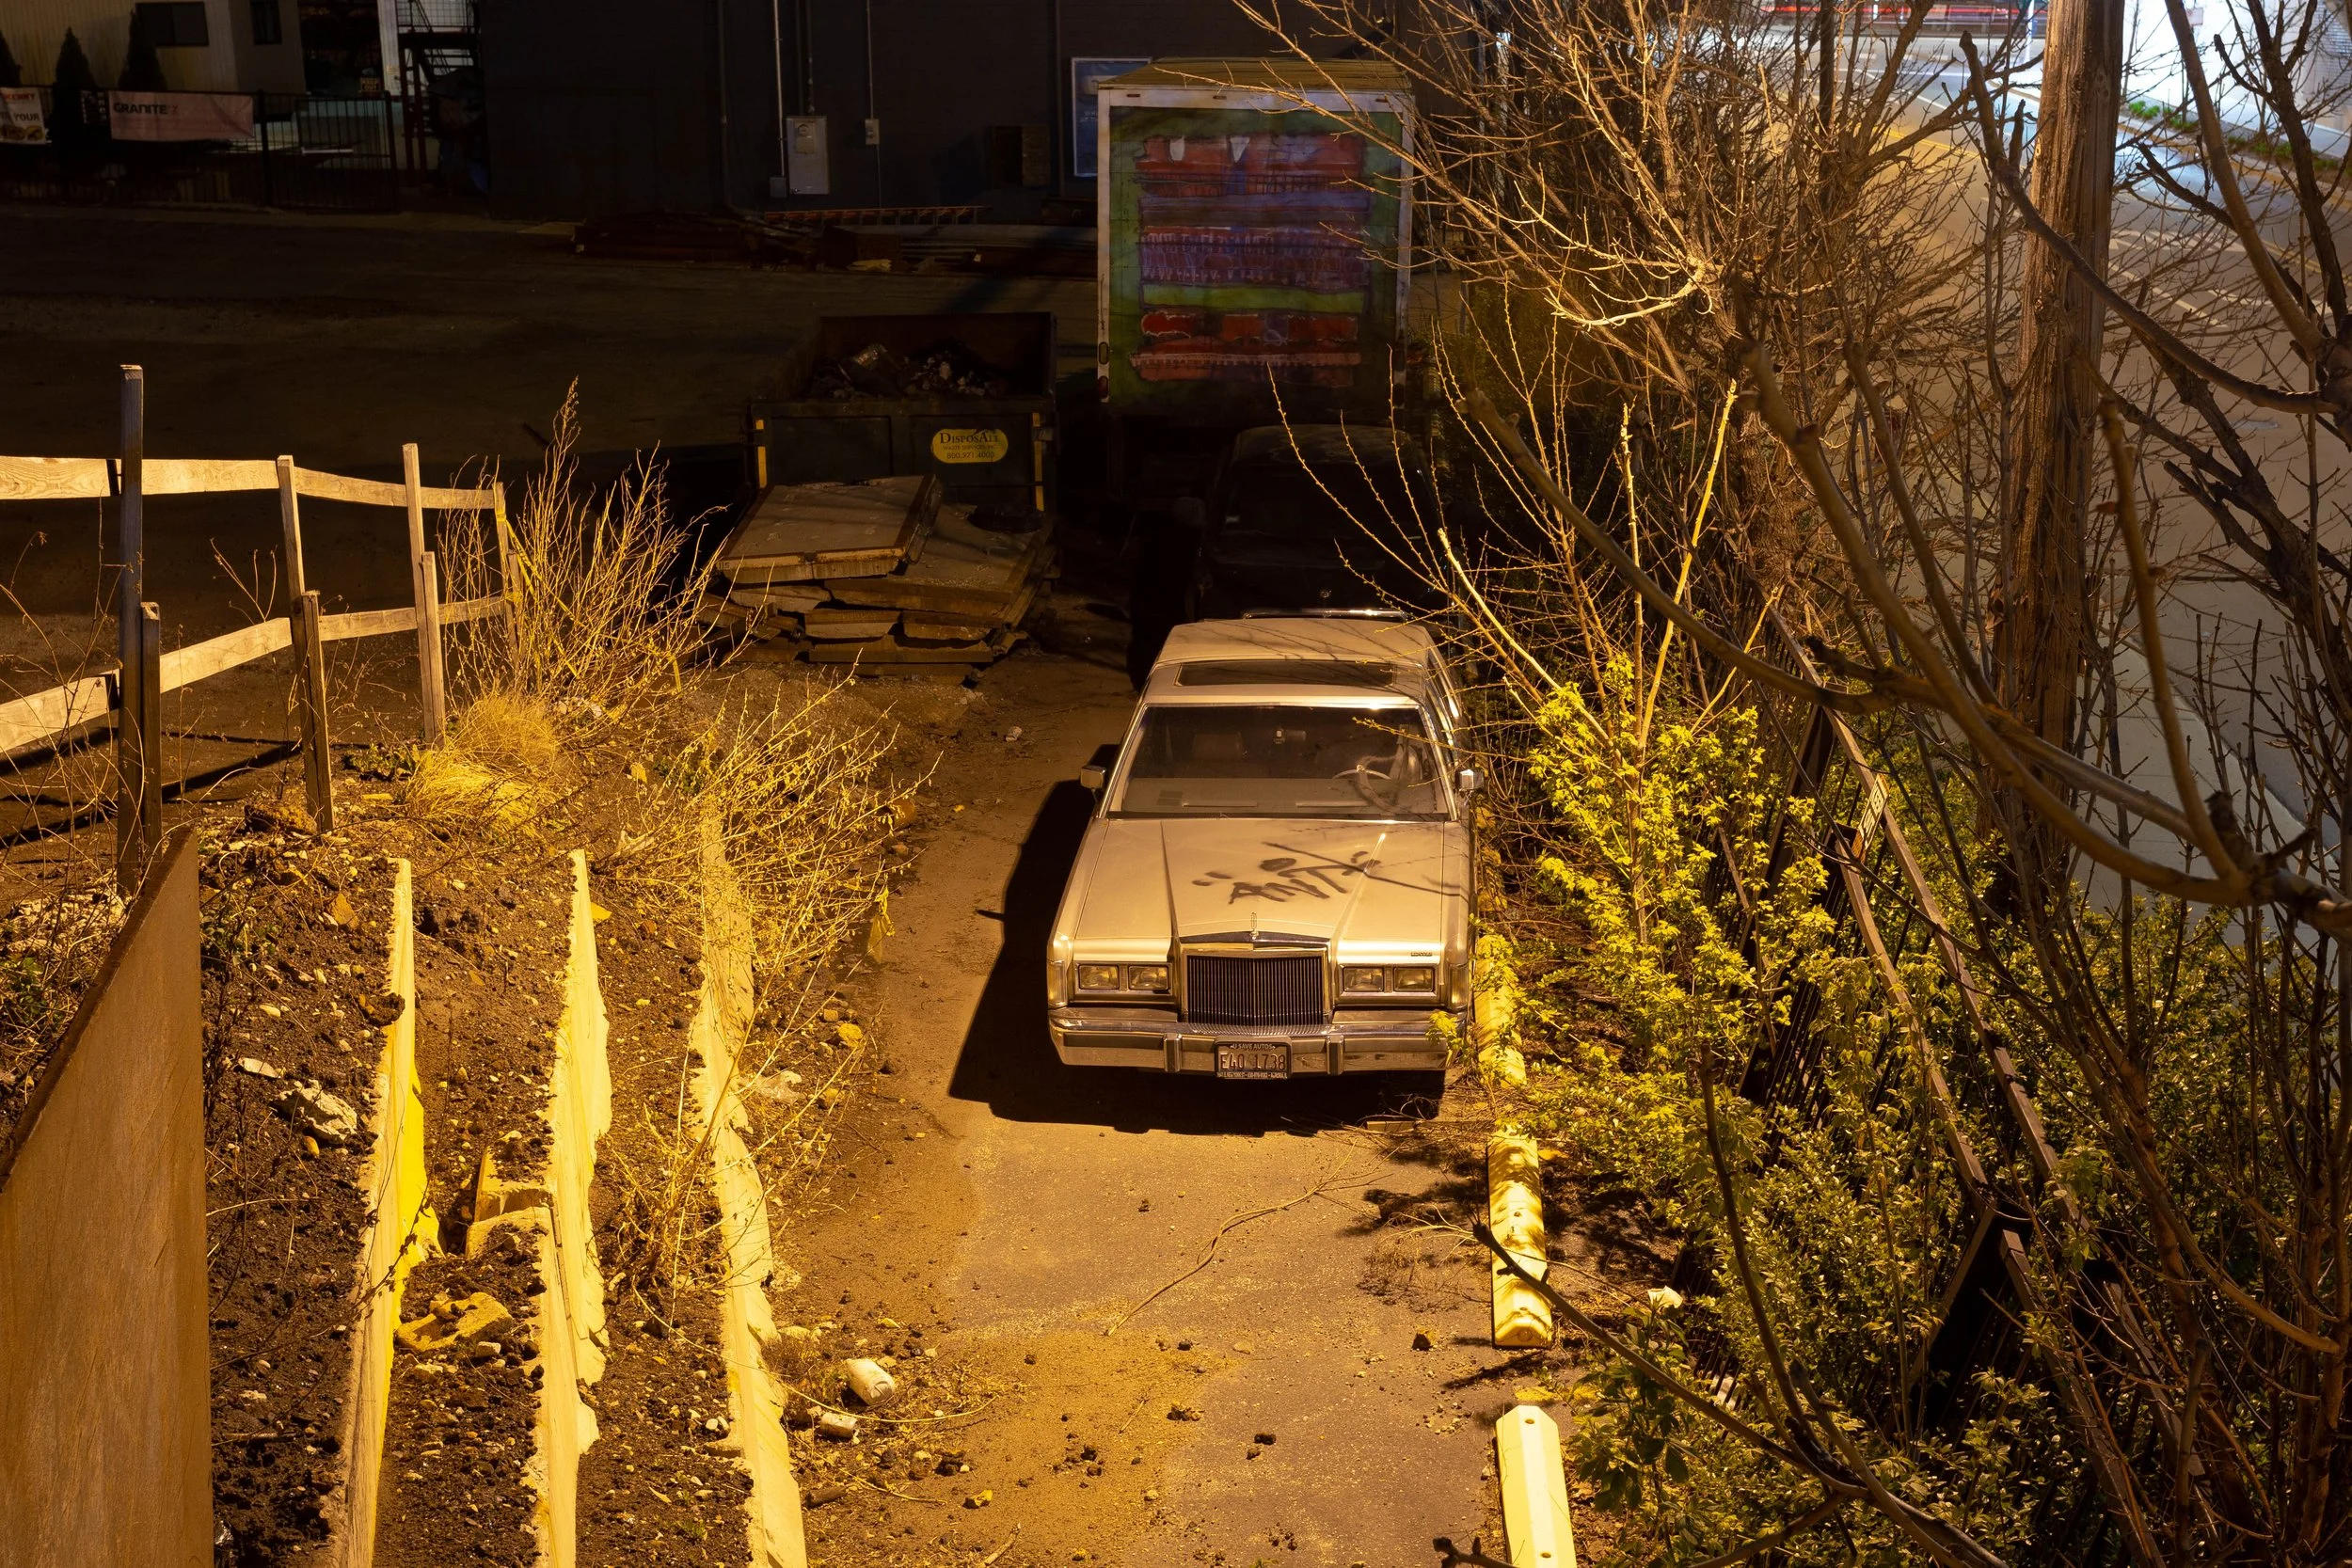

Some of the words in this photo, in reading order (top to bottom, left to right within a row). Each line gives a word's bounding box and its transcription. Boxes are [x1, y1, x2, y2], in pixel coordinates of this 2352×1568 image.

[113, 103, 167, 115] GRANITE
[13, 112, 40, 121] YOUR
[1220, 1053, 1246, 1070] E40
[1253, 1053, 1286, 1070] 1738
